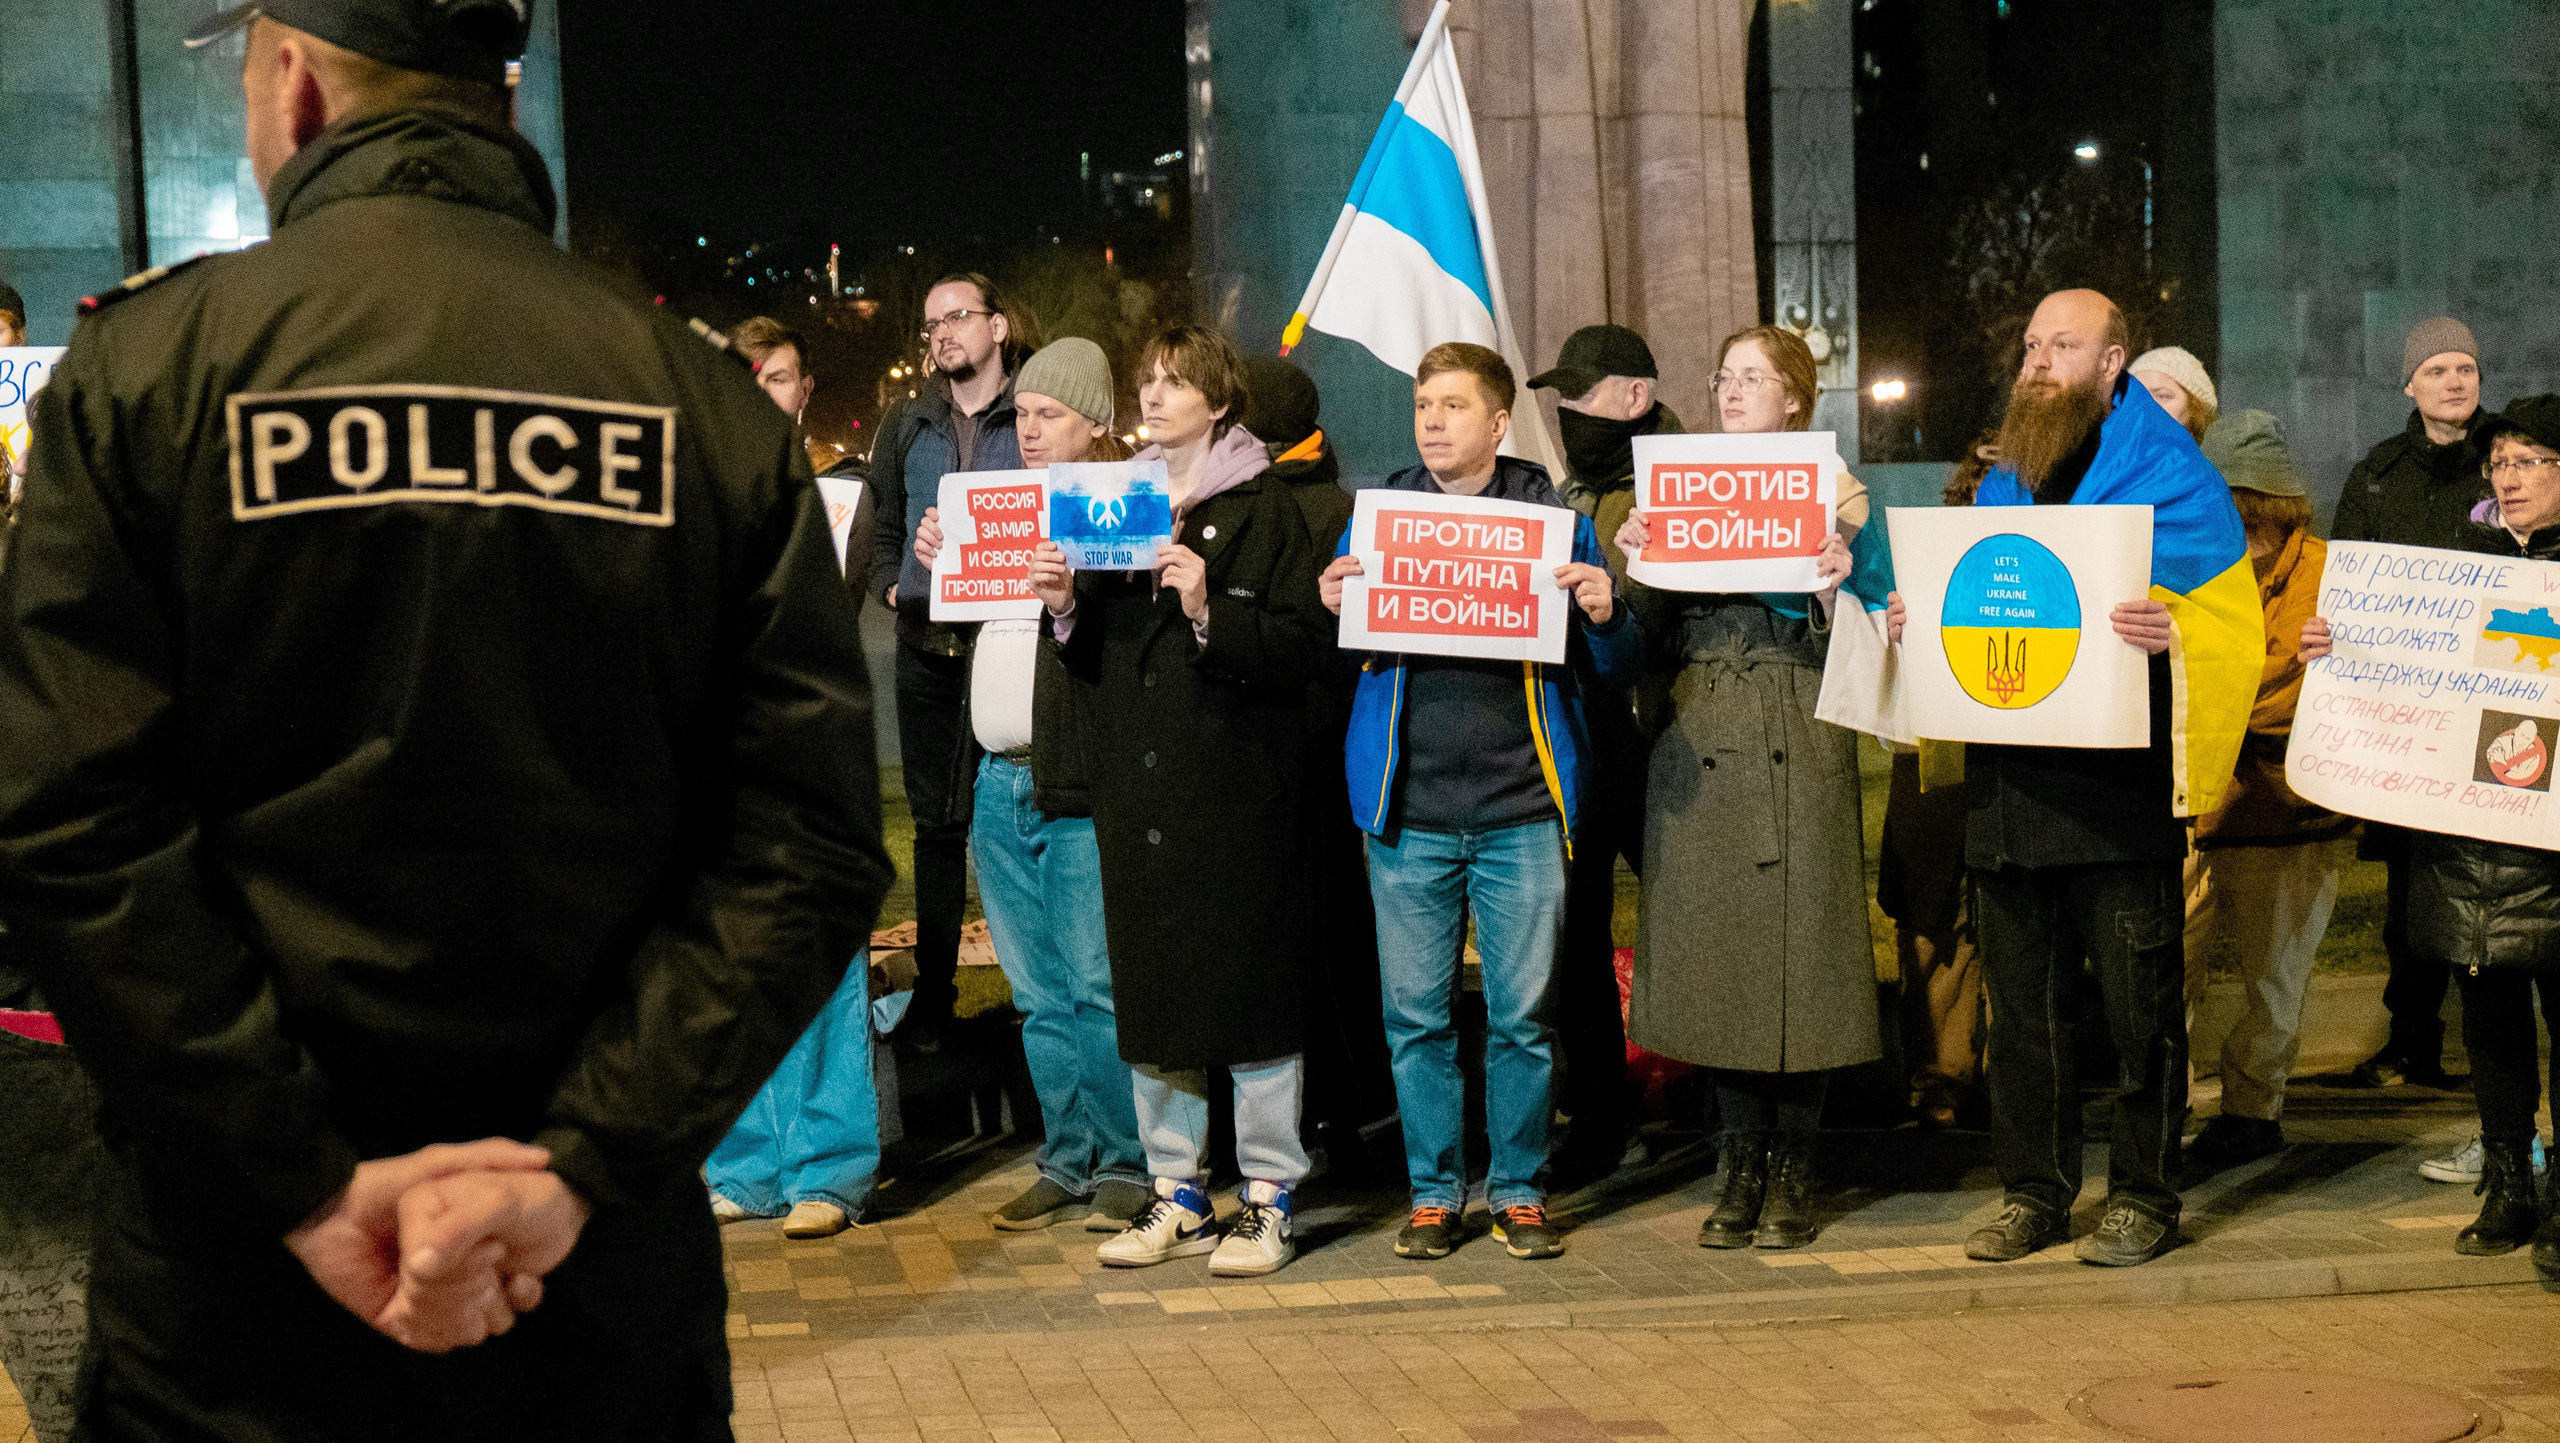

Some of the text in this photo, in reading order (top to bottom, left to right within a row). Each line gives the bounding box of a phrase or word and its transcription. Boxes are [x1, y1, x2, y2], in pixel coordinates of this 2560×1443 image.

[250, 404, 643, 508] POLICE
[972, 491, 1036, 511] РОССИЯ
[1659, 470, 1811, 502] ПРОТИВ
[981, 520, 1035, 538] ЗА МИР
[1392, 518, 1525, 551] ПРОТИВ
[1667, 510, 1802, 550] ВОЙНЫ
[968, 550, 979, 567] И
[1085, 551, 1133, 565] STOP WAR
[1994, 556, 2019, 567] LET'S
[2329, 550, 2369, 575] МЫ
[2367, 554, 2515, 588] РОССИЯНЕ
[945, 580, 1004, 597] ПРОТИВ
[1393, 560, 1518, 590] ПУТИНА
[1993, 573, 2020, 584] MAKE
[1986, 589, 2027, 600] UKRAINE
[2323, 587, 2474, 629] ПРОСИМ МИР
[1377, 594, 1530, 629] И ВОЙНЫ
[1979, 606, 2035, 618] FREE AGAIN
[2445, 672, 2549, 704] УКРАИНЫ
[2312, 692, 2456, 731] ОСТАНОВИТЕ
[2309, 722, 2413, 757] ПУТИНА
[2299, 754, 2542, 818] ОСТАНОВИТСЯ ВОЙНА!
